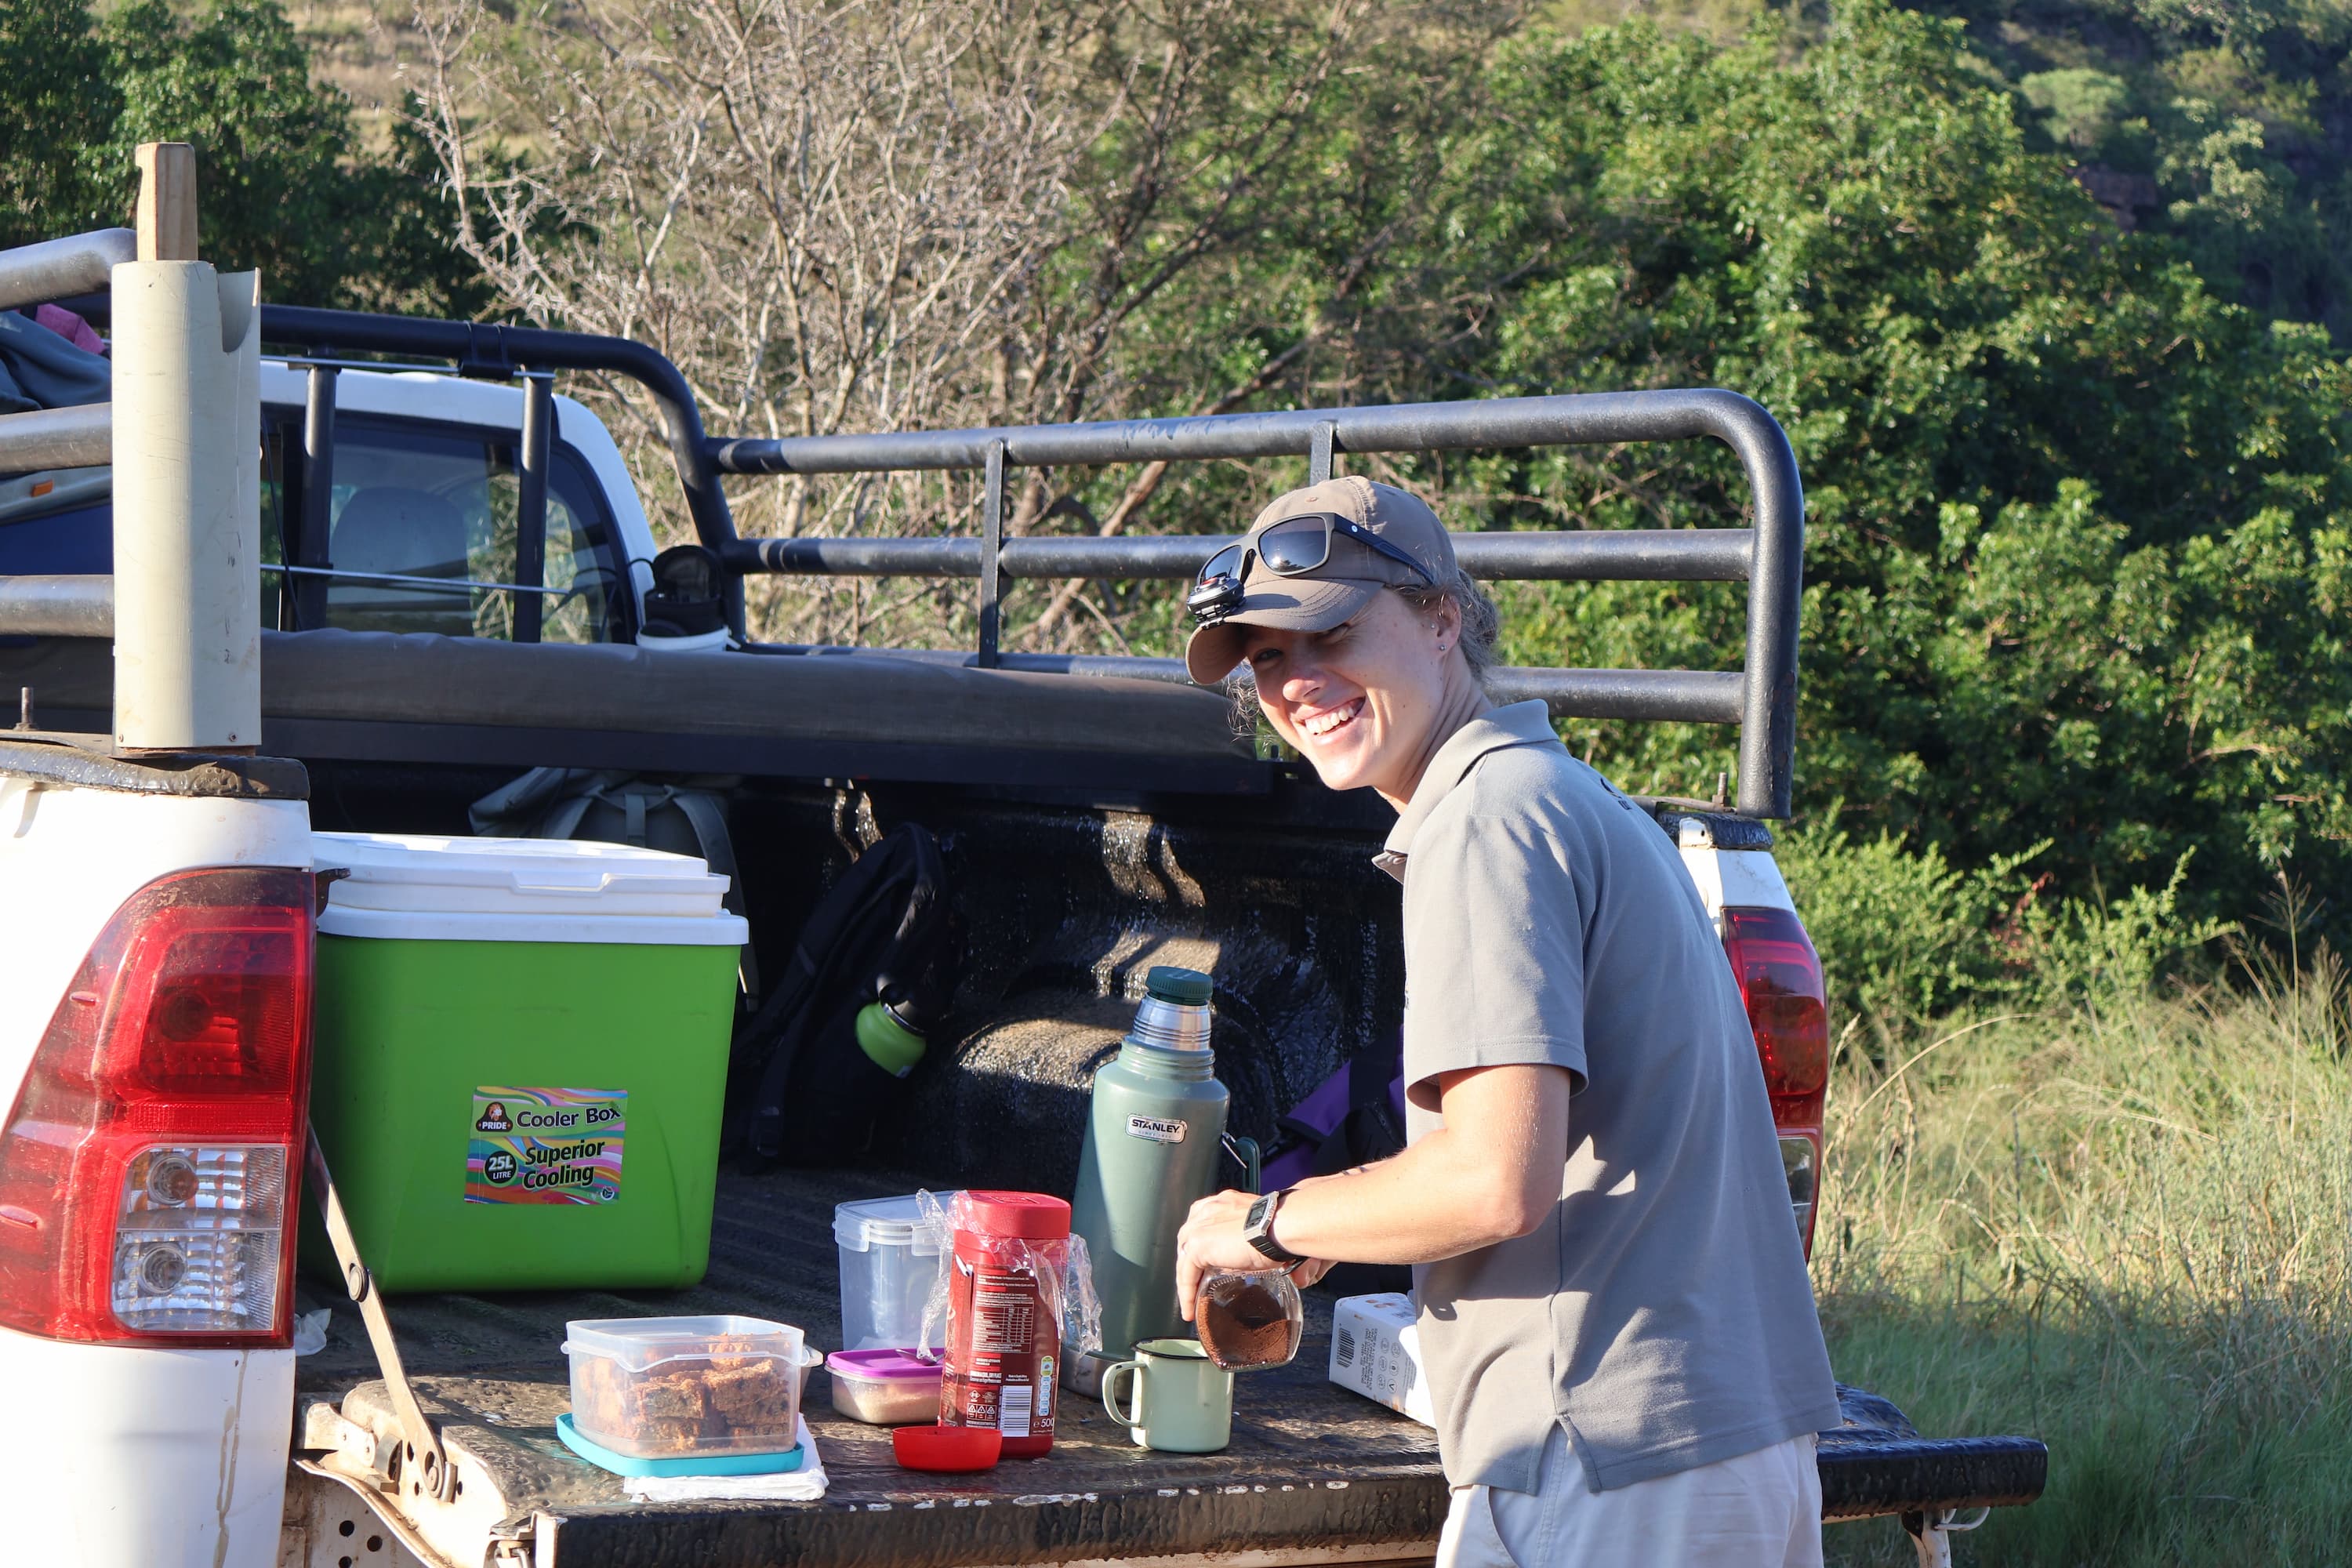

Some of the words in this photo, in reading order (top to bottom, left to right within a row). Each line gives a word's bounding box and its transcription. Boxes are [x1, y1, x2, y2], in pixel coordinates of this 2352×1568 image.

[482, 1121, 507, 1130] PRIDE
[517, 1111, 579, 1127] Cooler
[586, 1106, 621, 1123] Box
[1132, 1119, 1181, 1134] STANLEY
[525, 1139, 605, 1167] Superior
[488, 1154, 514, 1172] 25L
[492, 1170, 512, 1180] LITRE
[523, 1165, 594, 1189] Cooling
